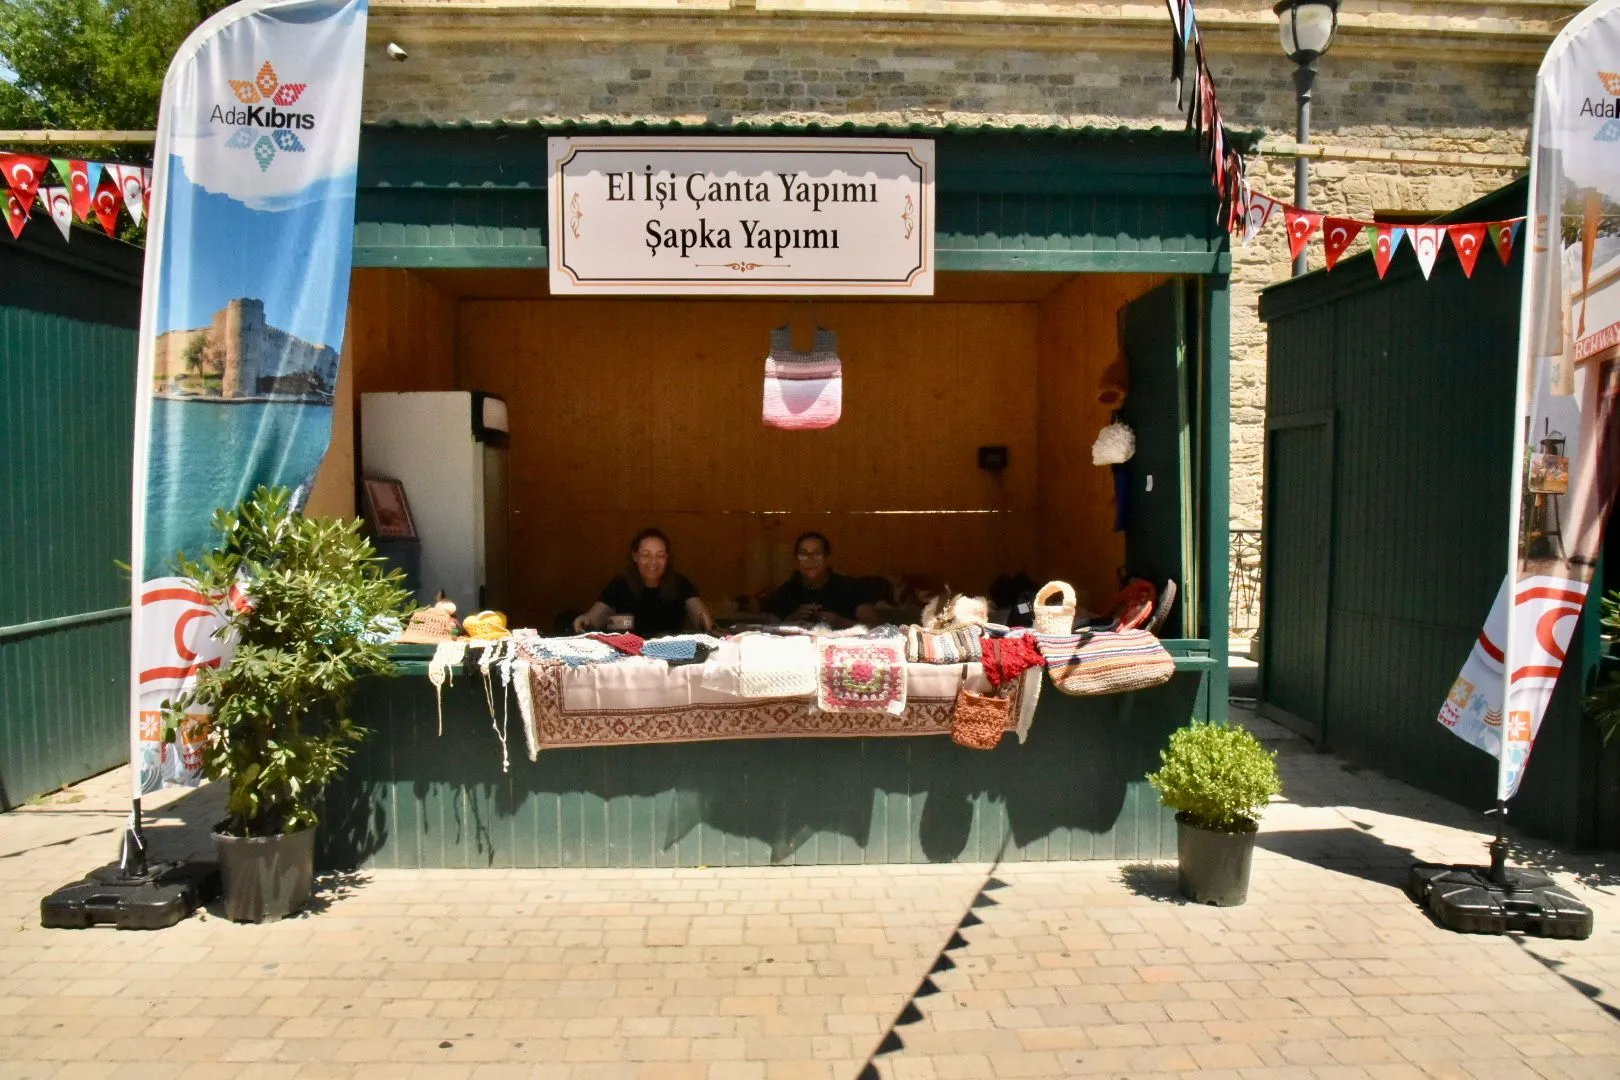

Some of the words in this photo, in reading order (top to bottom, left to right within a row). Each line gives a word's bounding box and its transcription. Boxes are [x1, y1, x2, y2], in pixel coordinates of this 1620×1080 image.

[606, 172, 635, 201] El
[643, 165, 677, 211] İşi
[685, 172, 770, 211] Çanta
[777, 173, 878, 212] Yapımı
[645, 219, 732, 258] Şapka
[739, 220, 840, 258] Yapımı
